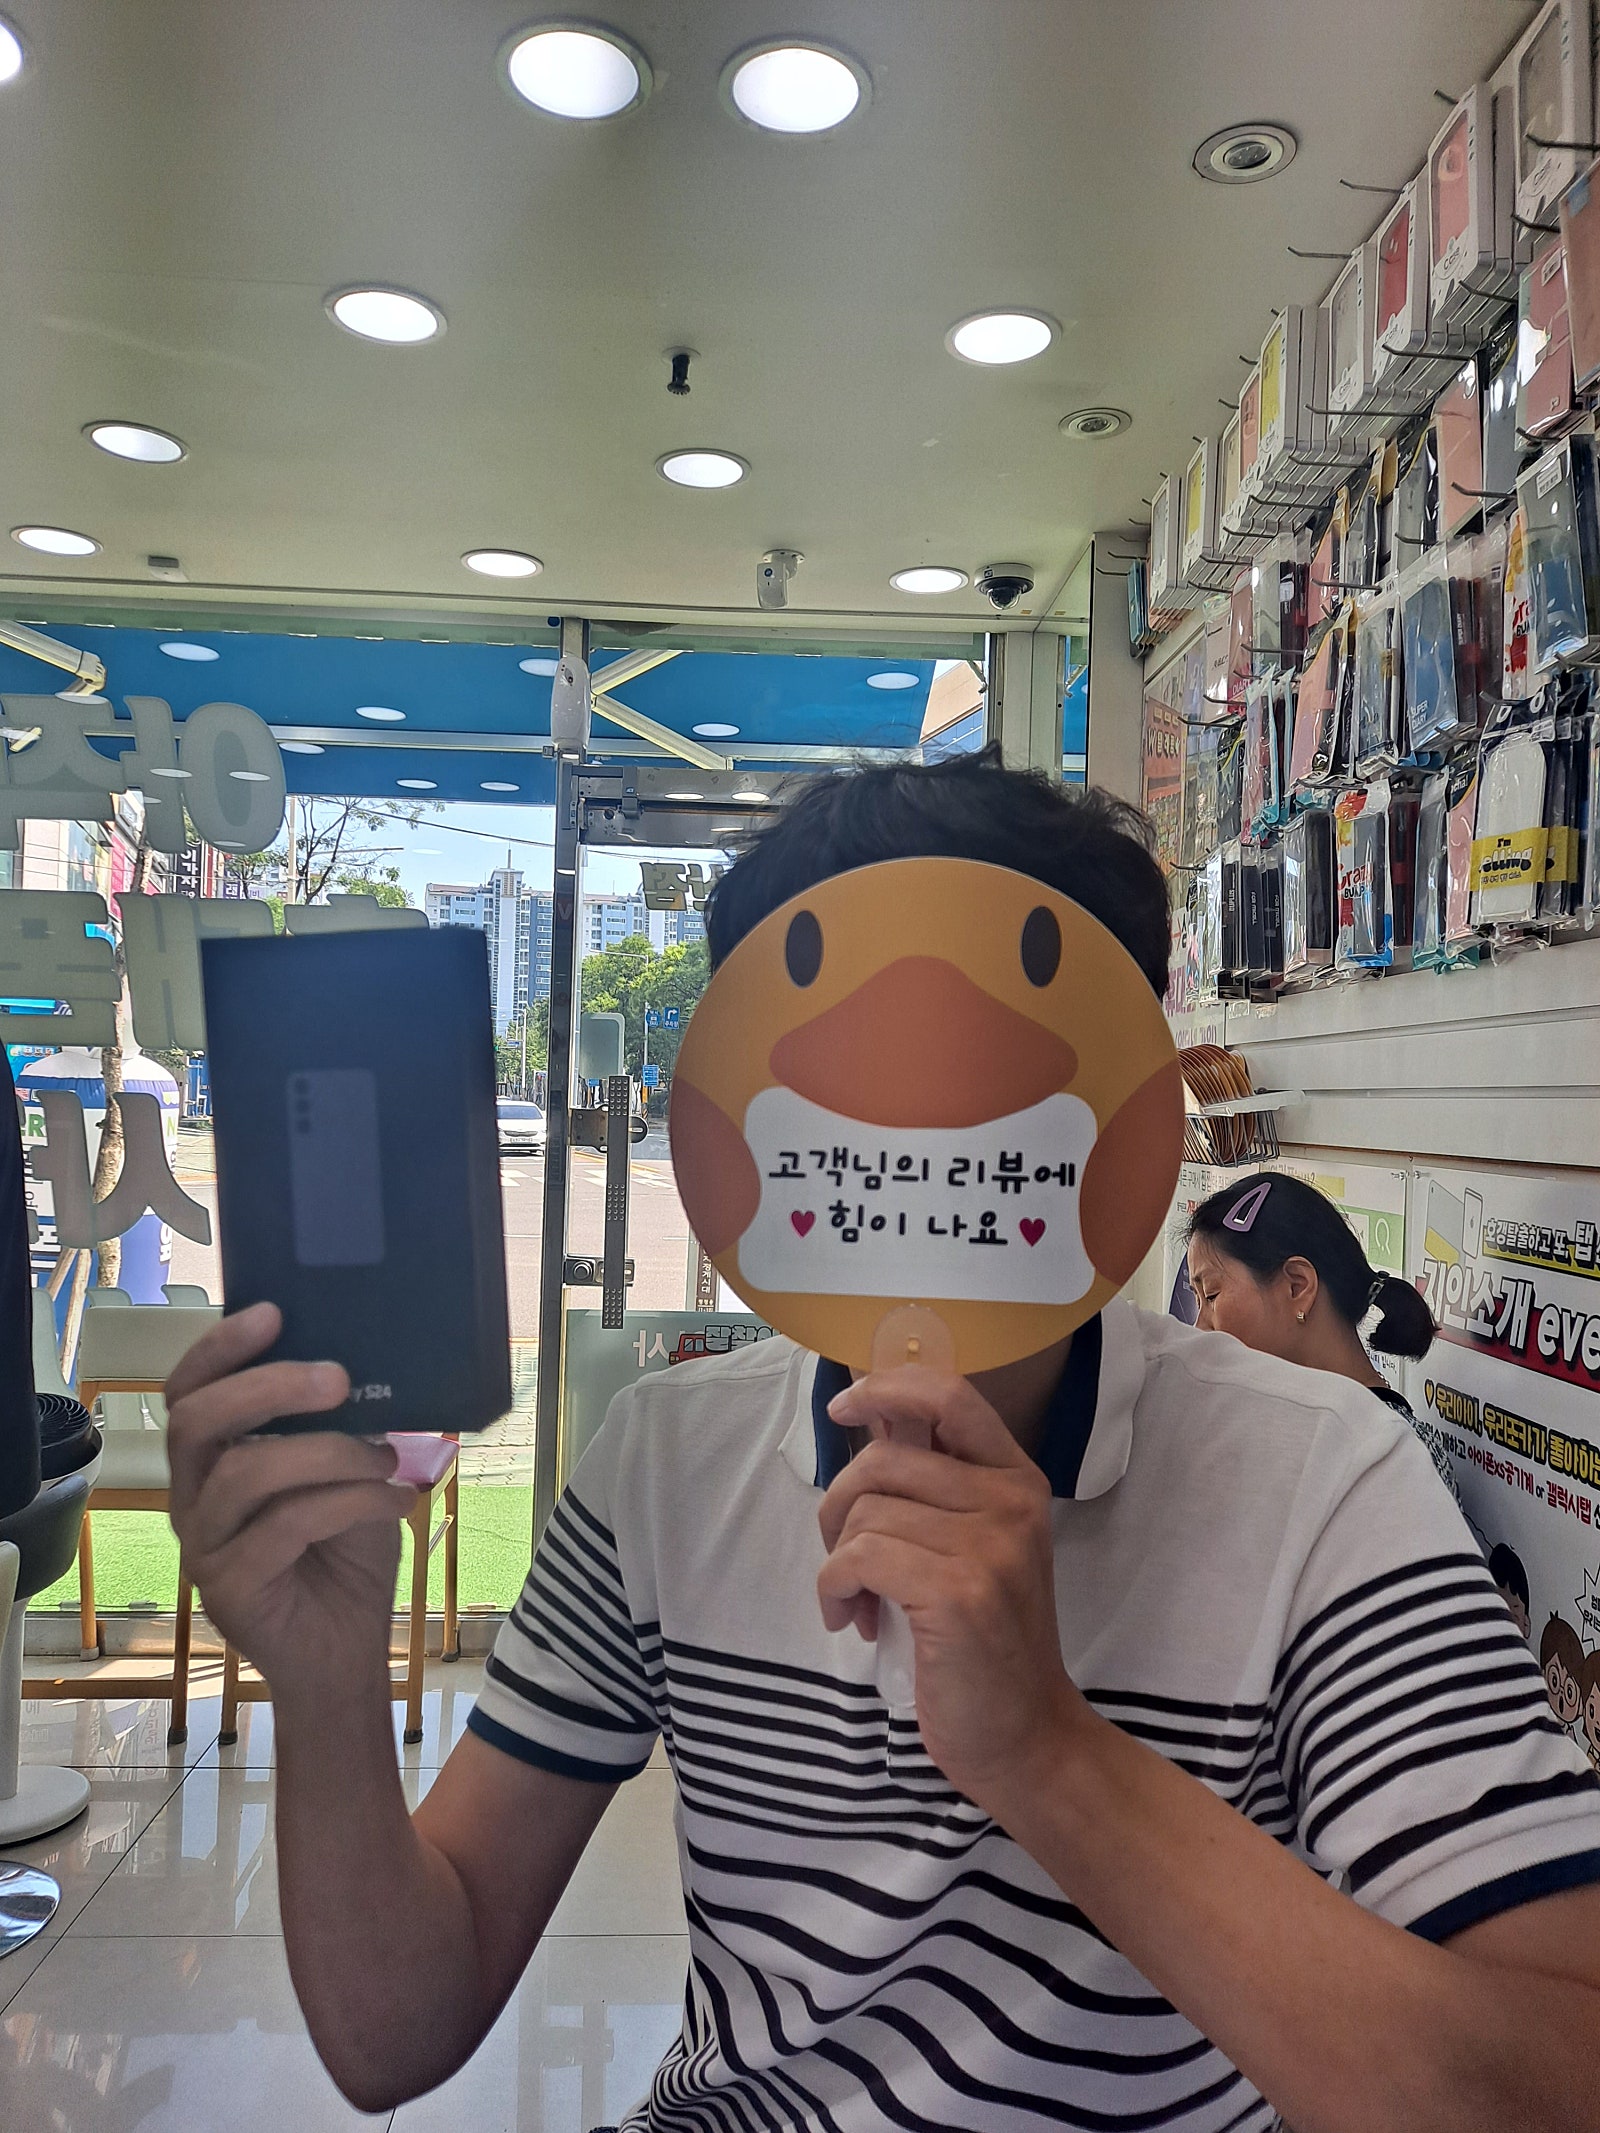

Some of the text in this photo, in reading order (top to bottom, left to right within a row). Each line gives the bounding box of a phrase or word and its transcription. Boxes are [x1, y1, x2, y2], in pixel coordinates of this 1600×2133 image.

[768, 1147, 1076, 1194] 고객님의 리뷰에
[829, 1199, 1008, 1245] 힘이 나요
[1486, 1217, 1553, 1255] 호갱탈출하고
[1423, 1258, 1536, 1351] 지인소개
[1483, 1402, 1549, 1465] 우리조카가
[1546, 1480, 1592, 1525] 갤럭시탭
